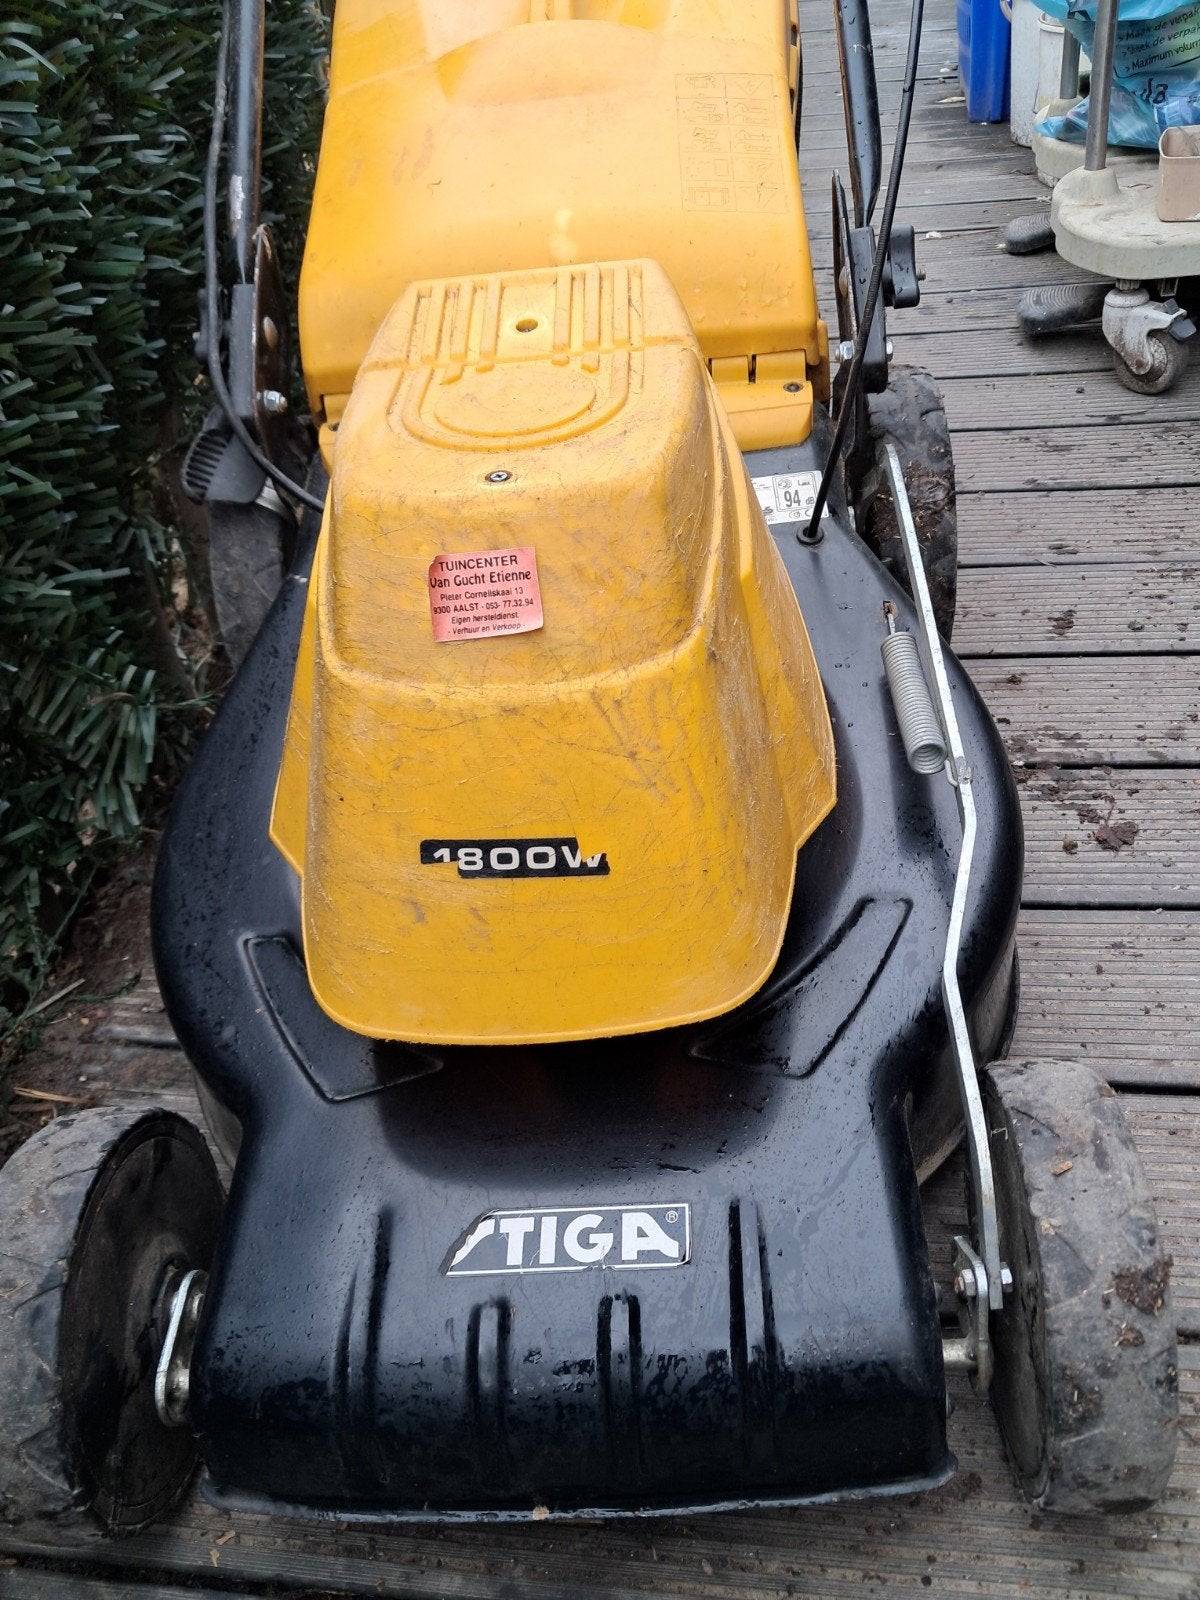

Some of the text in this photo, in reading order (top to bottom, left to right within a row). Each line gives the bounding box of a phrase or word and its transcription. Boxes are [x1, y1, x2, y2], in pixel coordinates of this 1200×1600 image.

[1155, 20, 1168, 31] de
[1153, 34, 1165, 46] de
[1132, 49, 1174, 70] Maximum
[784, 489, 802, 508] 94
[438, 554, 518, 572] TUINCENTER
[453, 573, 485, 586] Gucht
[490, 570, 532, 583] Etienne
[440, 593, 462, 602] Pieter
[515, 587, 524, 595] 13
[433, 606, 451, 614] 9300
[453, 603, 479, 613] AALST
[503, 598, 534, 608] 77.32.94
[451, 616, 471, 625] Eigen
[453, 626, 480, 635] Verhuur
[492, 623, 521, 632] Verkoop
[433, 846, 602, 870] 1800W
